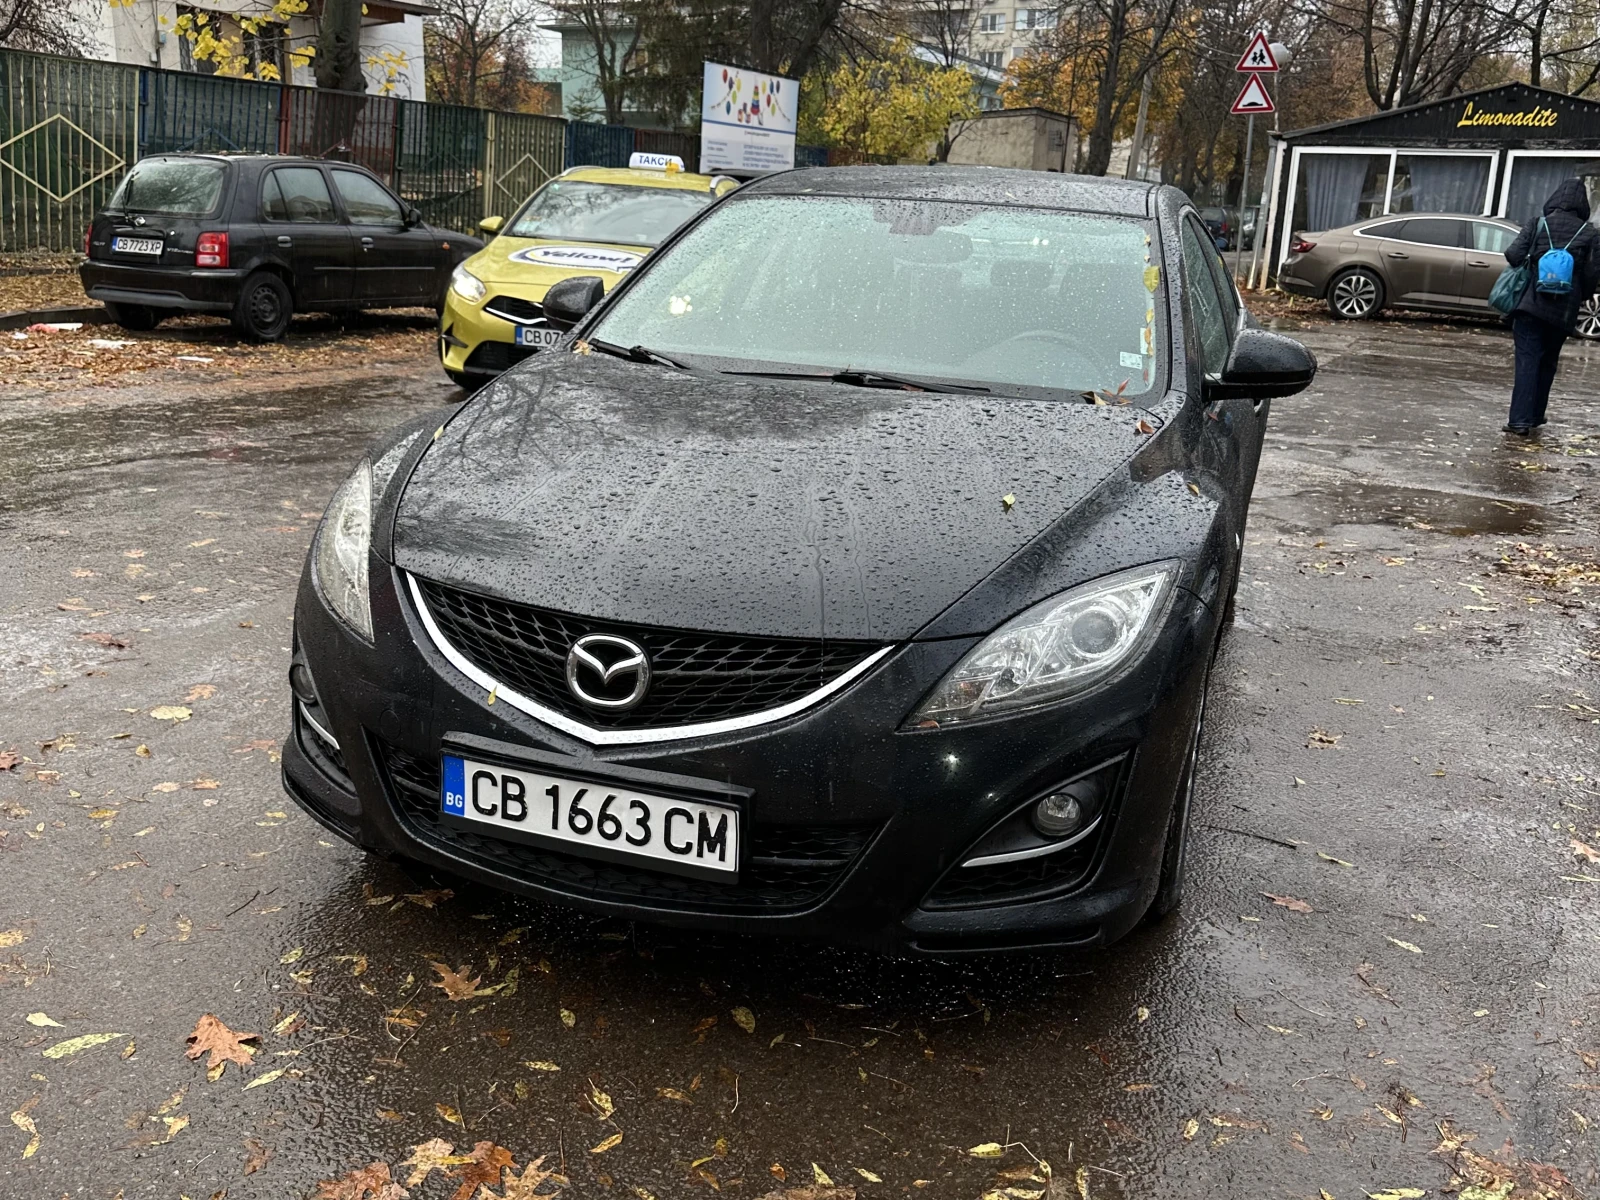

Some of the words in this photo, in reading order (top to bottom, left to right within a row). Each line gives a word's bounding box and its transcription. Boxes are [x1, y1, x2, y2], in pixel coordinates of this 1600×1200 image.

[1457, 101, 1558, 127] Limonadite
[639, 155, 672, 166] ТАКСИ
[129, 240, 149, 251] 7723
[524, 329, 542, 344] CB
[544, 331, 564, 345] 07
[446, 791, 463, 808] BG
[471, 769, 528, 822] CB
[545, 784, 651, 847] 1663
[663, 807, 728, 862] CM
